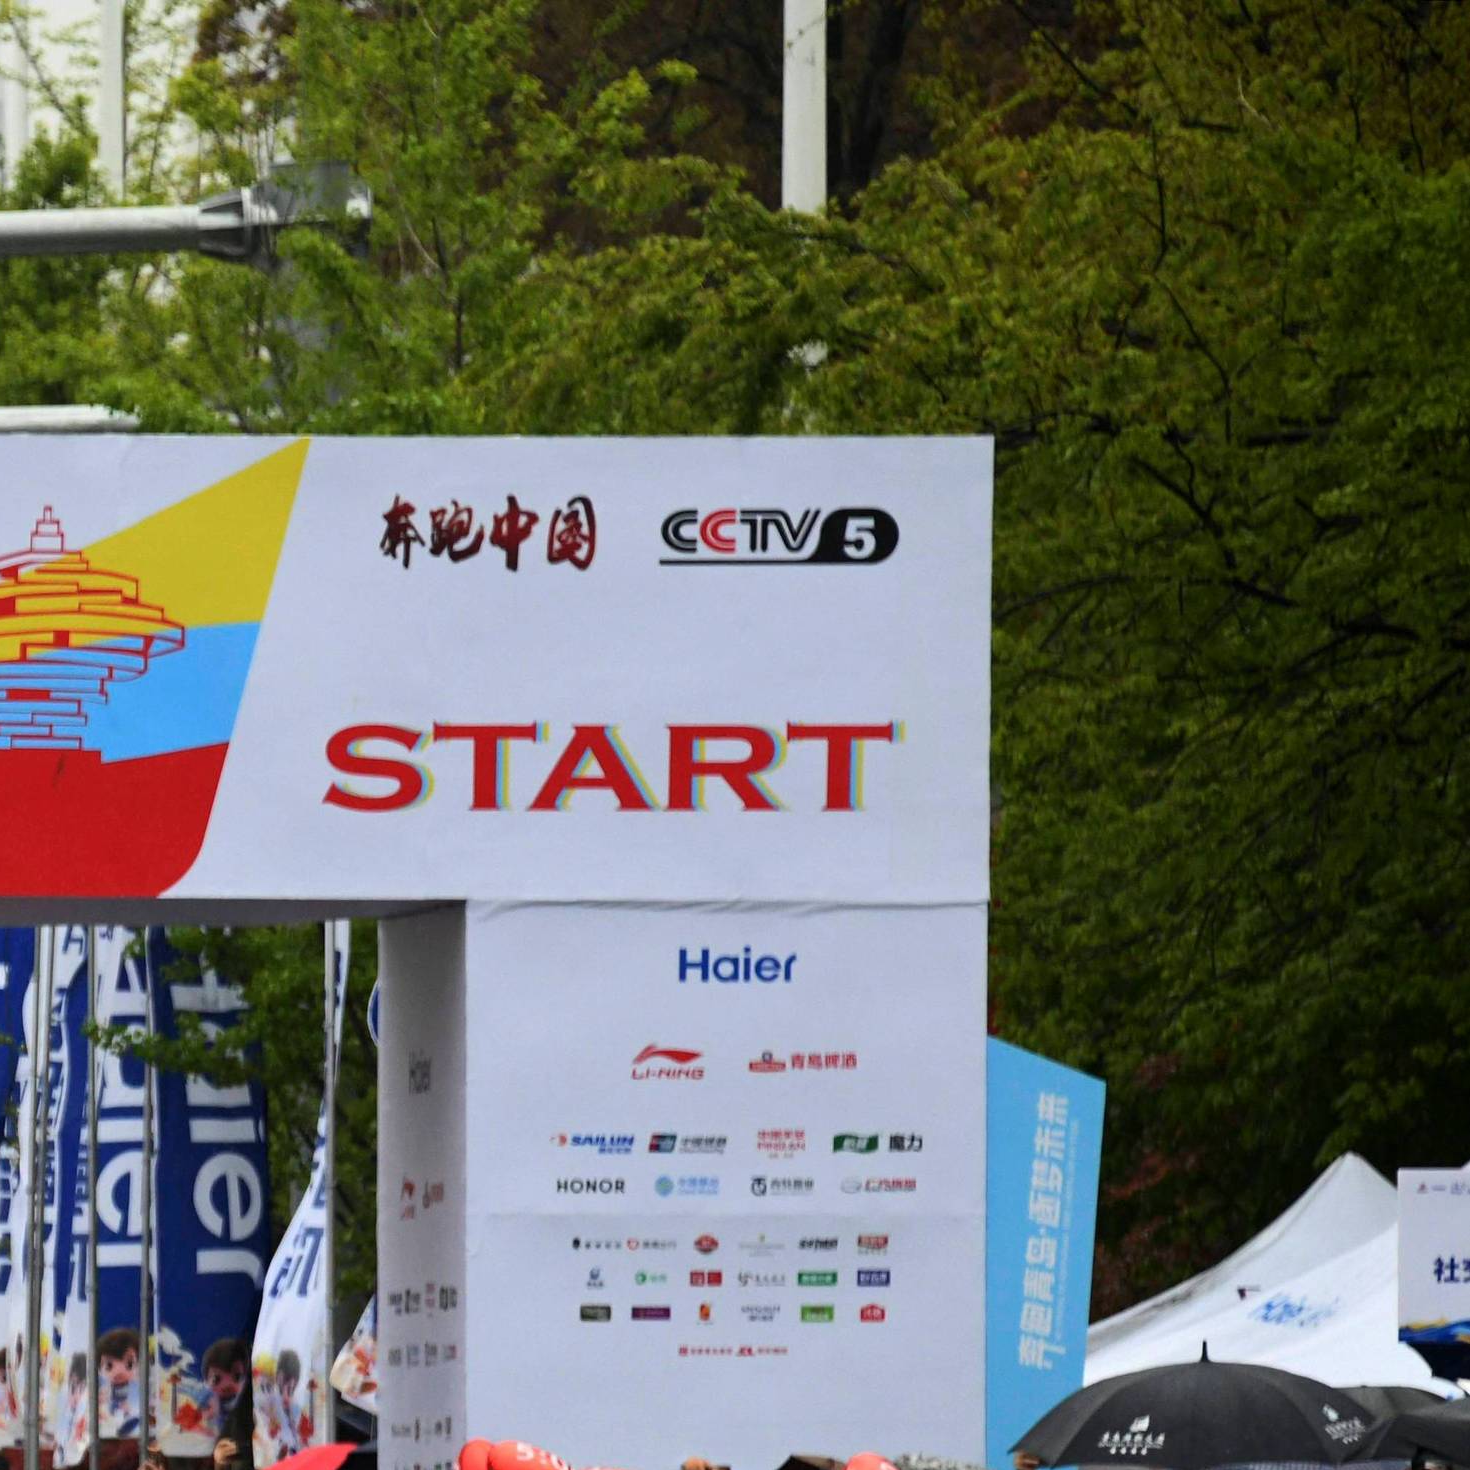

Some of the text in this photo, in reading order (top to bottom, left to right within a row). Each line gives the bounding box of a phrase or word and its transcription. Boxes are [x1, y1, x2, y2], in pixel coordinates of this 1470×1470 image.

[379, 494, 597, 571] 奔跑中国
[322, 720, 903, 811] START
[678, 946, 797, 983] Haier
[557, 1179, 626, 1194] HONOR
